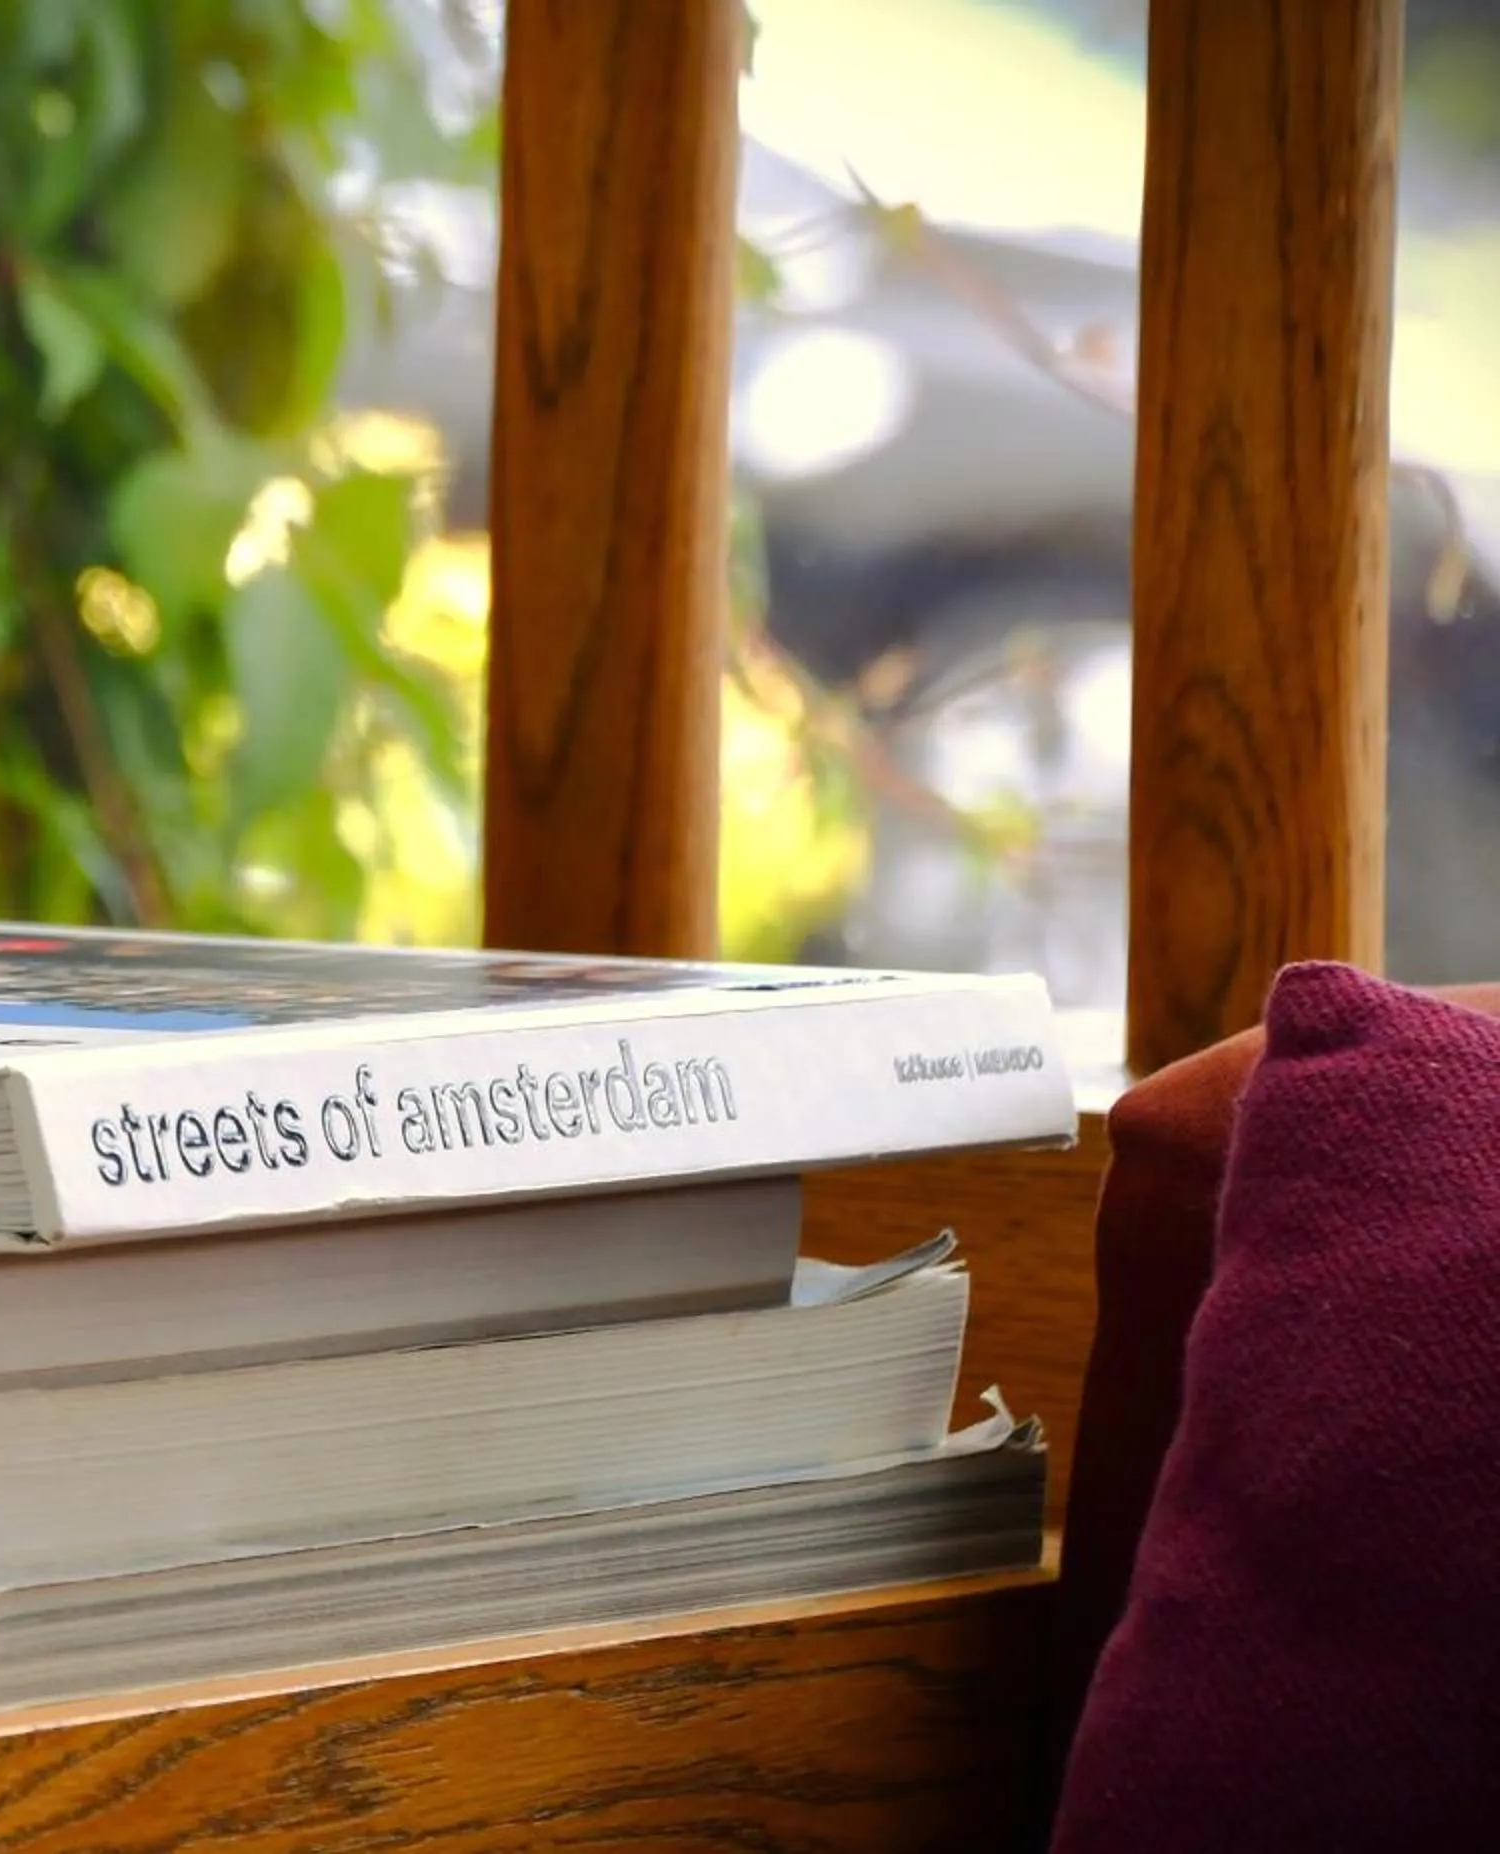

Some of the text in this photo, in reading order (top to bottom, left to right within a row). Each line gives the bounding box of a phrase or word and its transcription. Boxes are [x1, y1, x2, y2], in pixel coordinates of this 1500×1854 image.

[91, 1039, 737, 1187] streets of amsterdam
